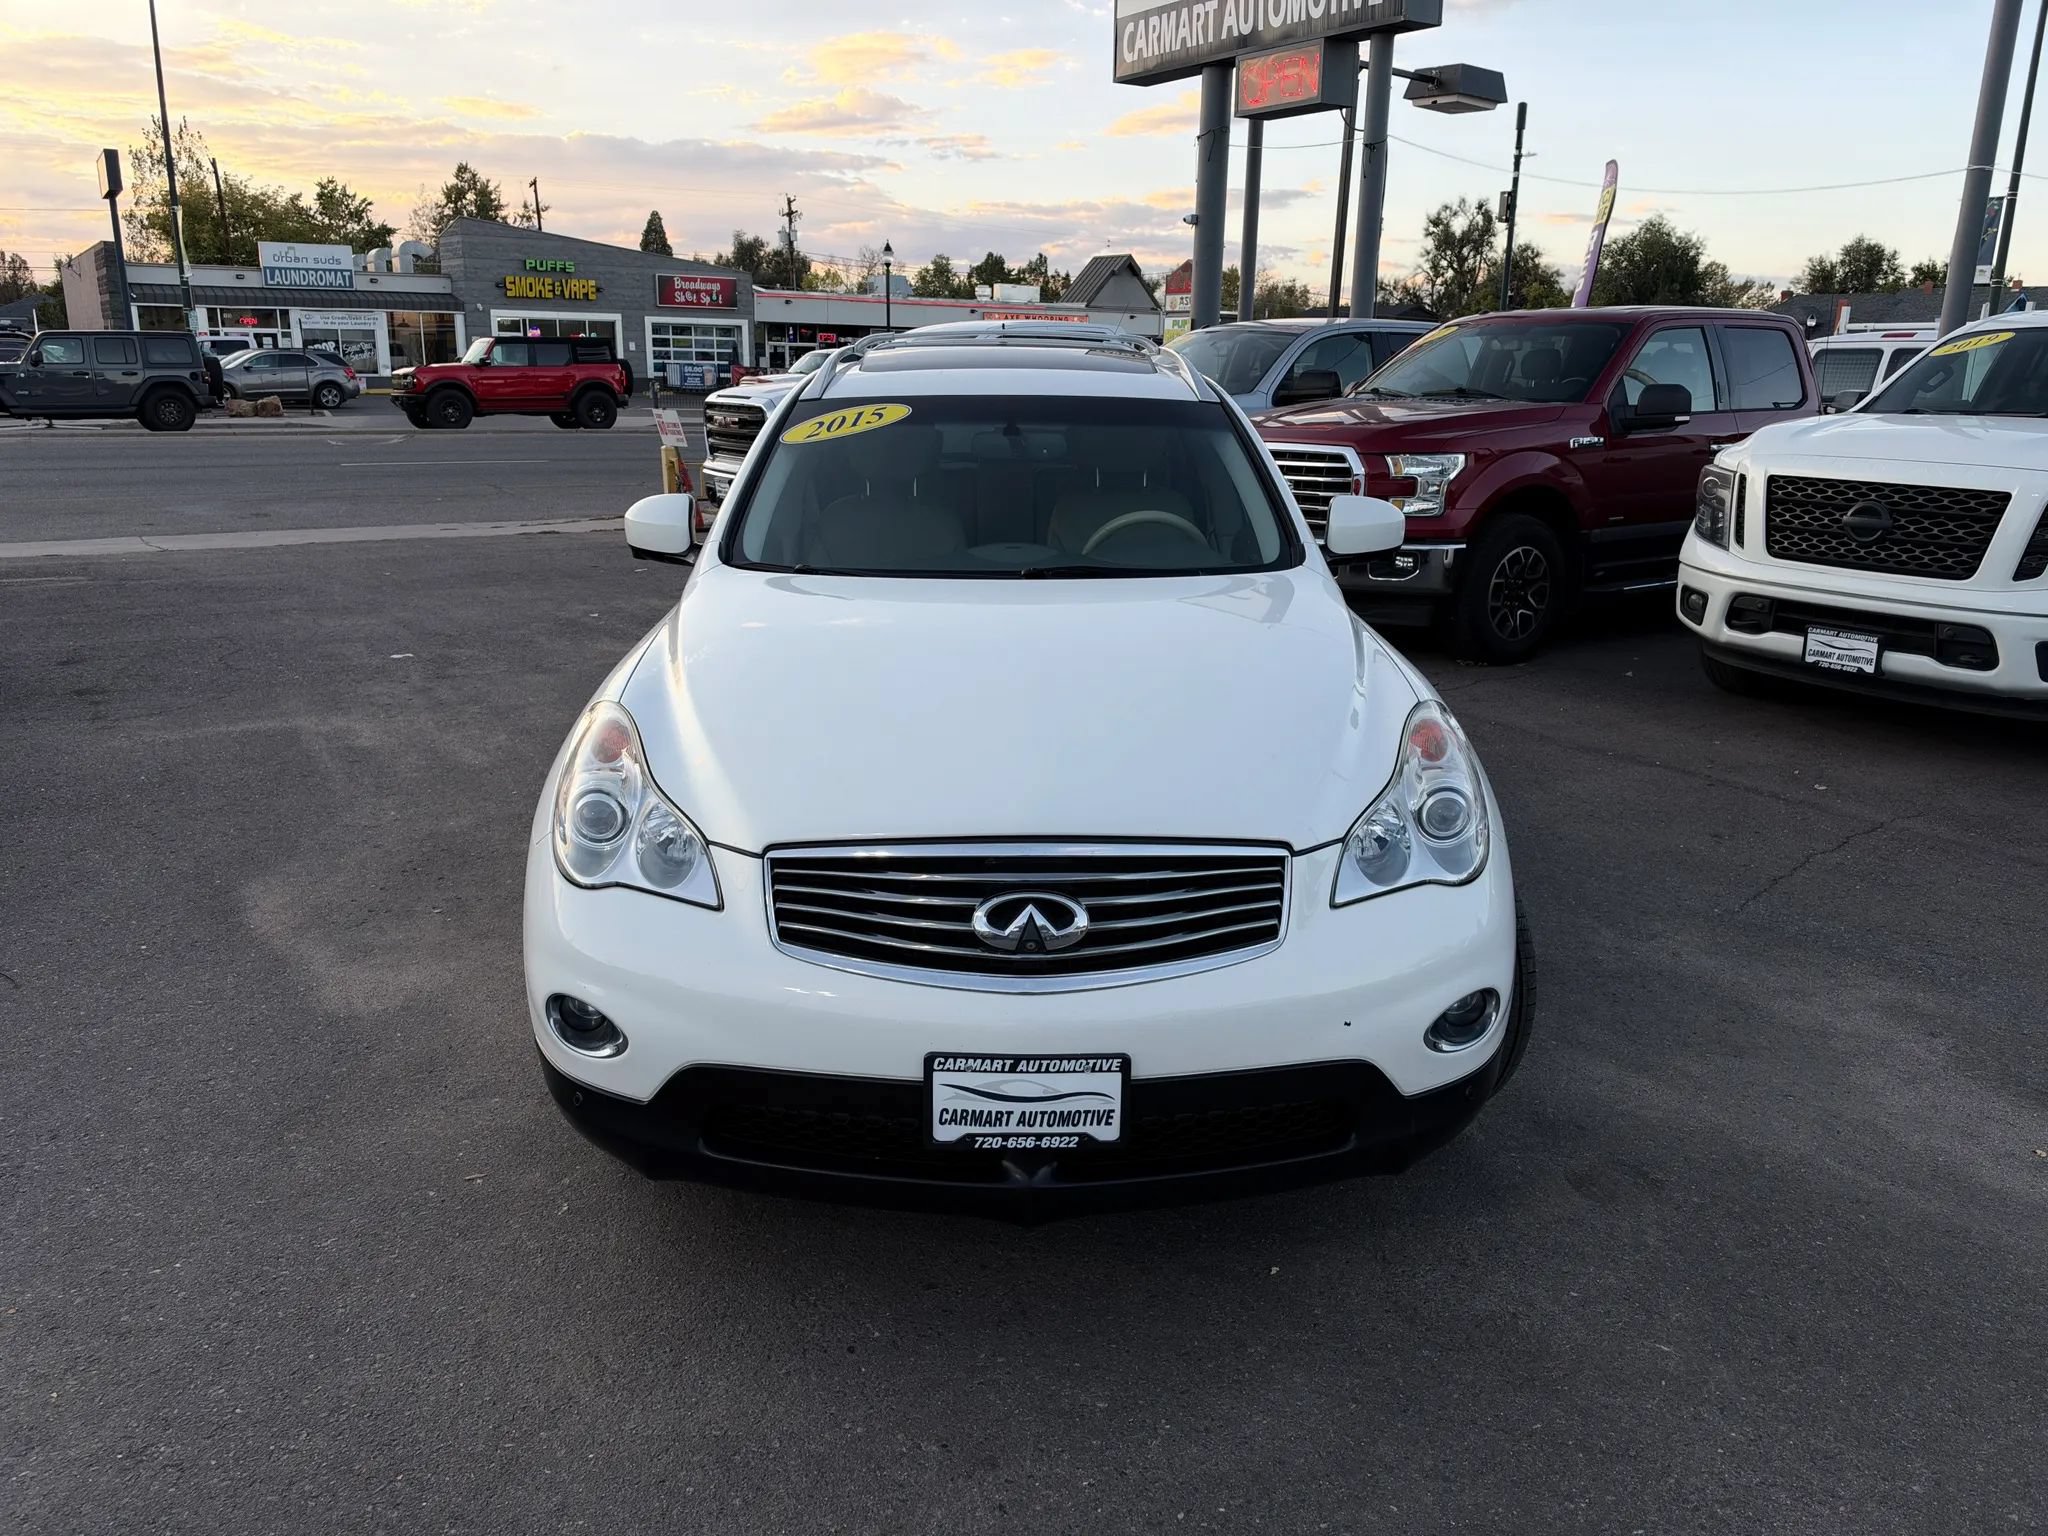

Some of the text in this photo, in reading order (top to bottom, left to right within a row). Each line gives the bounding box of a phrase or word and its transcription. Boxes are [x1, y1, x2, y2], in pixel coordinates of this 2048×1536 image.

[1123, 0, 1218, 63] CARMART
[1243, 53, 1320, 106] OPEN
[273, 249, 342, 265] urban suds
[525, 259, 575, 273] PUFFS
[266, 268, 350, 287] LAUNDROMAT
[674, 276, 720, 292] Broadways
[505, 275, 597, 300] SMOKE & VAPE
[240, 317, 258, 325] OPEN
[804, 406, 887, 440] 2015
[1808, 627, 1878, 642] CARMART AUTOMOTIVE
[1808, 648, 1874, 666] CARMART AUTOMOTIVE
[933, 1058, 1122, 1072] CARMART AUTOMOTIVE
[938, 1108, 1116, 1128] CARMART AUTOMOTIVE
[974, 1136, 1080, 1149] 720-656-6922
